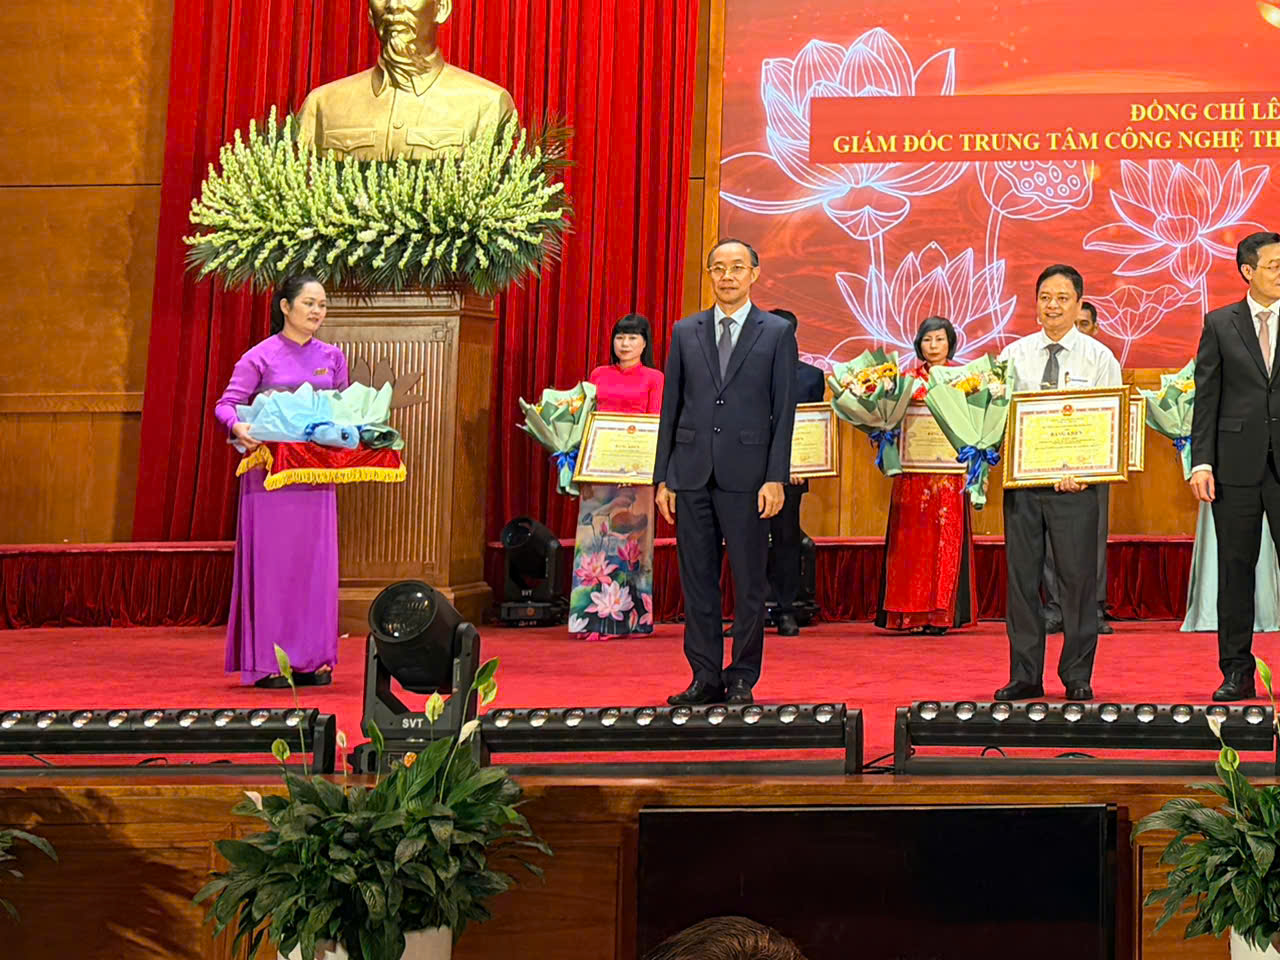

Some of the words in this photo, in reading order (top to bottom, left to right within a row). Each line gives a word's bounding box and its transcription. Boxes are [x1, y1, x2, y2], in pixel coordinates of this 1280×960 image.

[1130, 99, 1198, 122] ĐỒNG
[1203, 97, 1245, 121] CHÍ
[1252, 96, 1280, 120] LÊ
[833, 130, 897, 153] GIÁM
[903, 129, 953, 152] ĐỐC
[959, 133, 1040, 151] TRUNG
[1046, 127, 1099, 150] TÂM
[1104, 126, 1172, 149] CÔNG
[1177, 127, 1244, 152] NGHỆ
[402, 718, 425, 729] SVT
